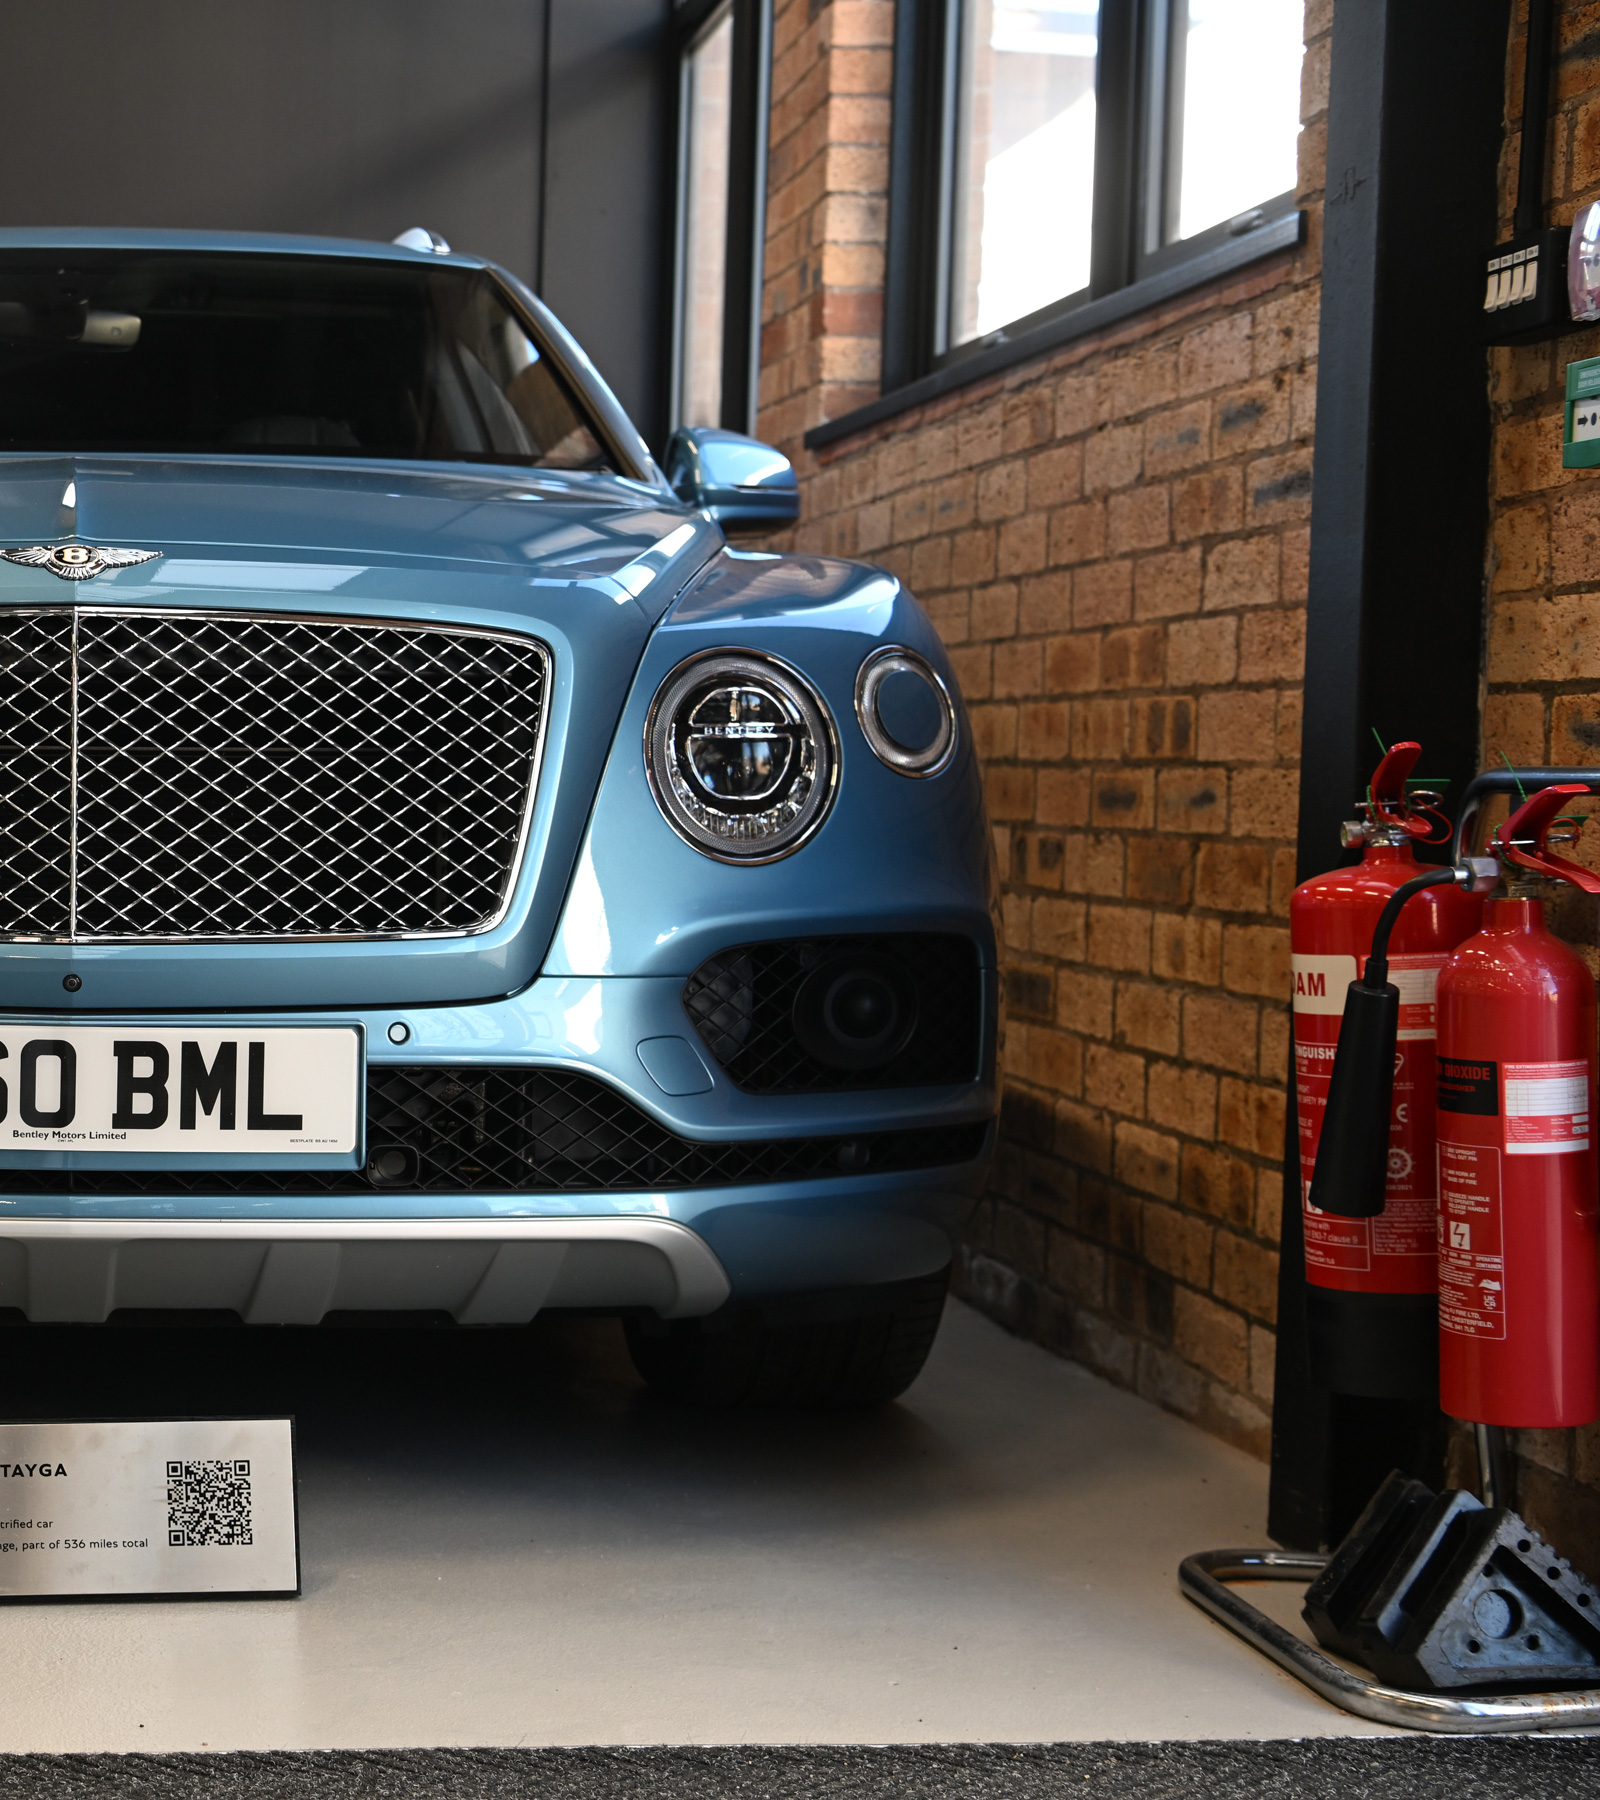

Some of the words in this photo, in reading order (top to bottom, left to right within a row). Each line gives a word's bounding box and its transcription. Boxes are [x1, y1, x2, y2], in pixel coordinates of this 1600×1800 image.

[704, 725, 774, 735] BENTLEY
[1444, 1063, 1491, 1080] DIOXIDE
[112, 1041, 303, 1131] BML
[13, 1130, 49, 1140] Bentley
[52, 1131, 86, 1139] Motors
[89, 1132, 127, 1140] Limited
[1327, 1234, 1351, 1243] clause
[36, 1520, 53, 1529] car
[22, 1541, 45, 1553] part
[49, 1540, 61, 1550] of
[64, 1539, 86, 1549] 536
[89, 1539, 118, 1549] miles
[122, 1538, 149, 1548] total
